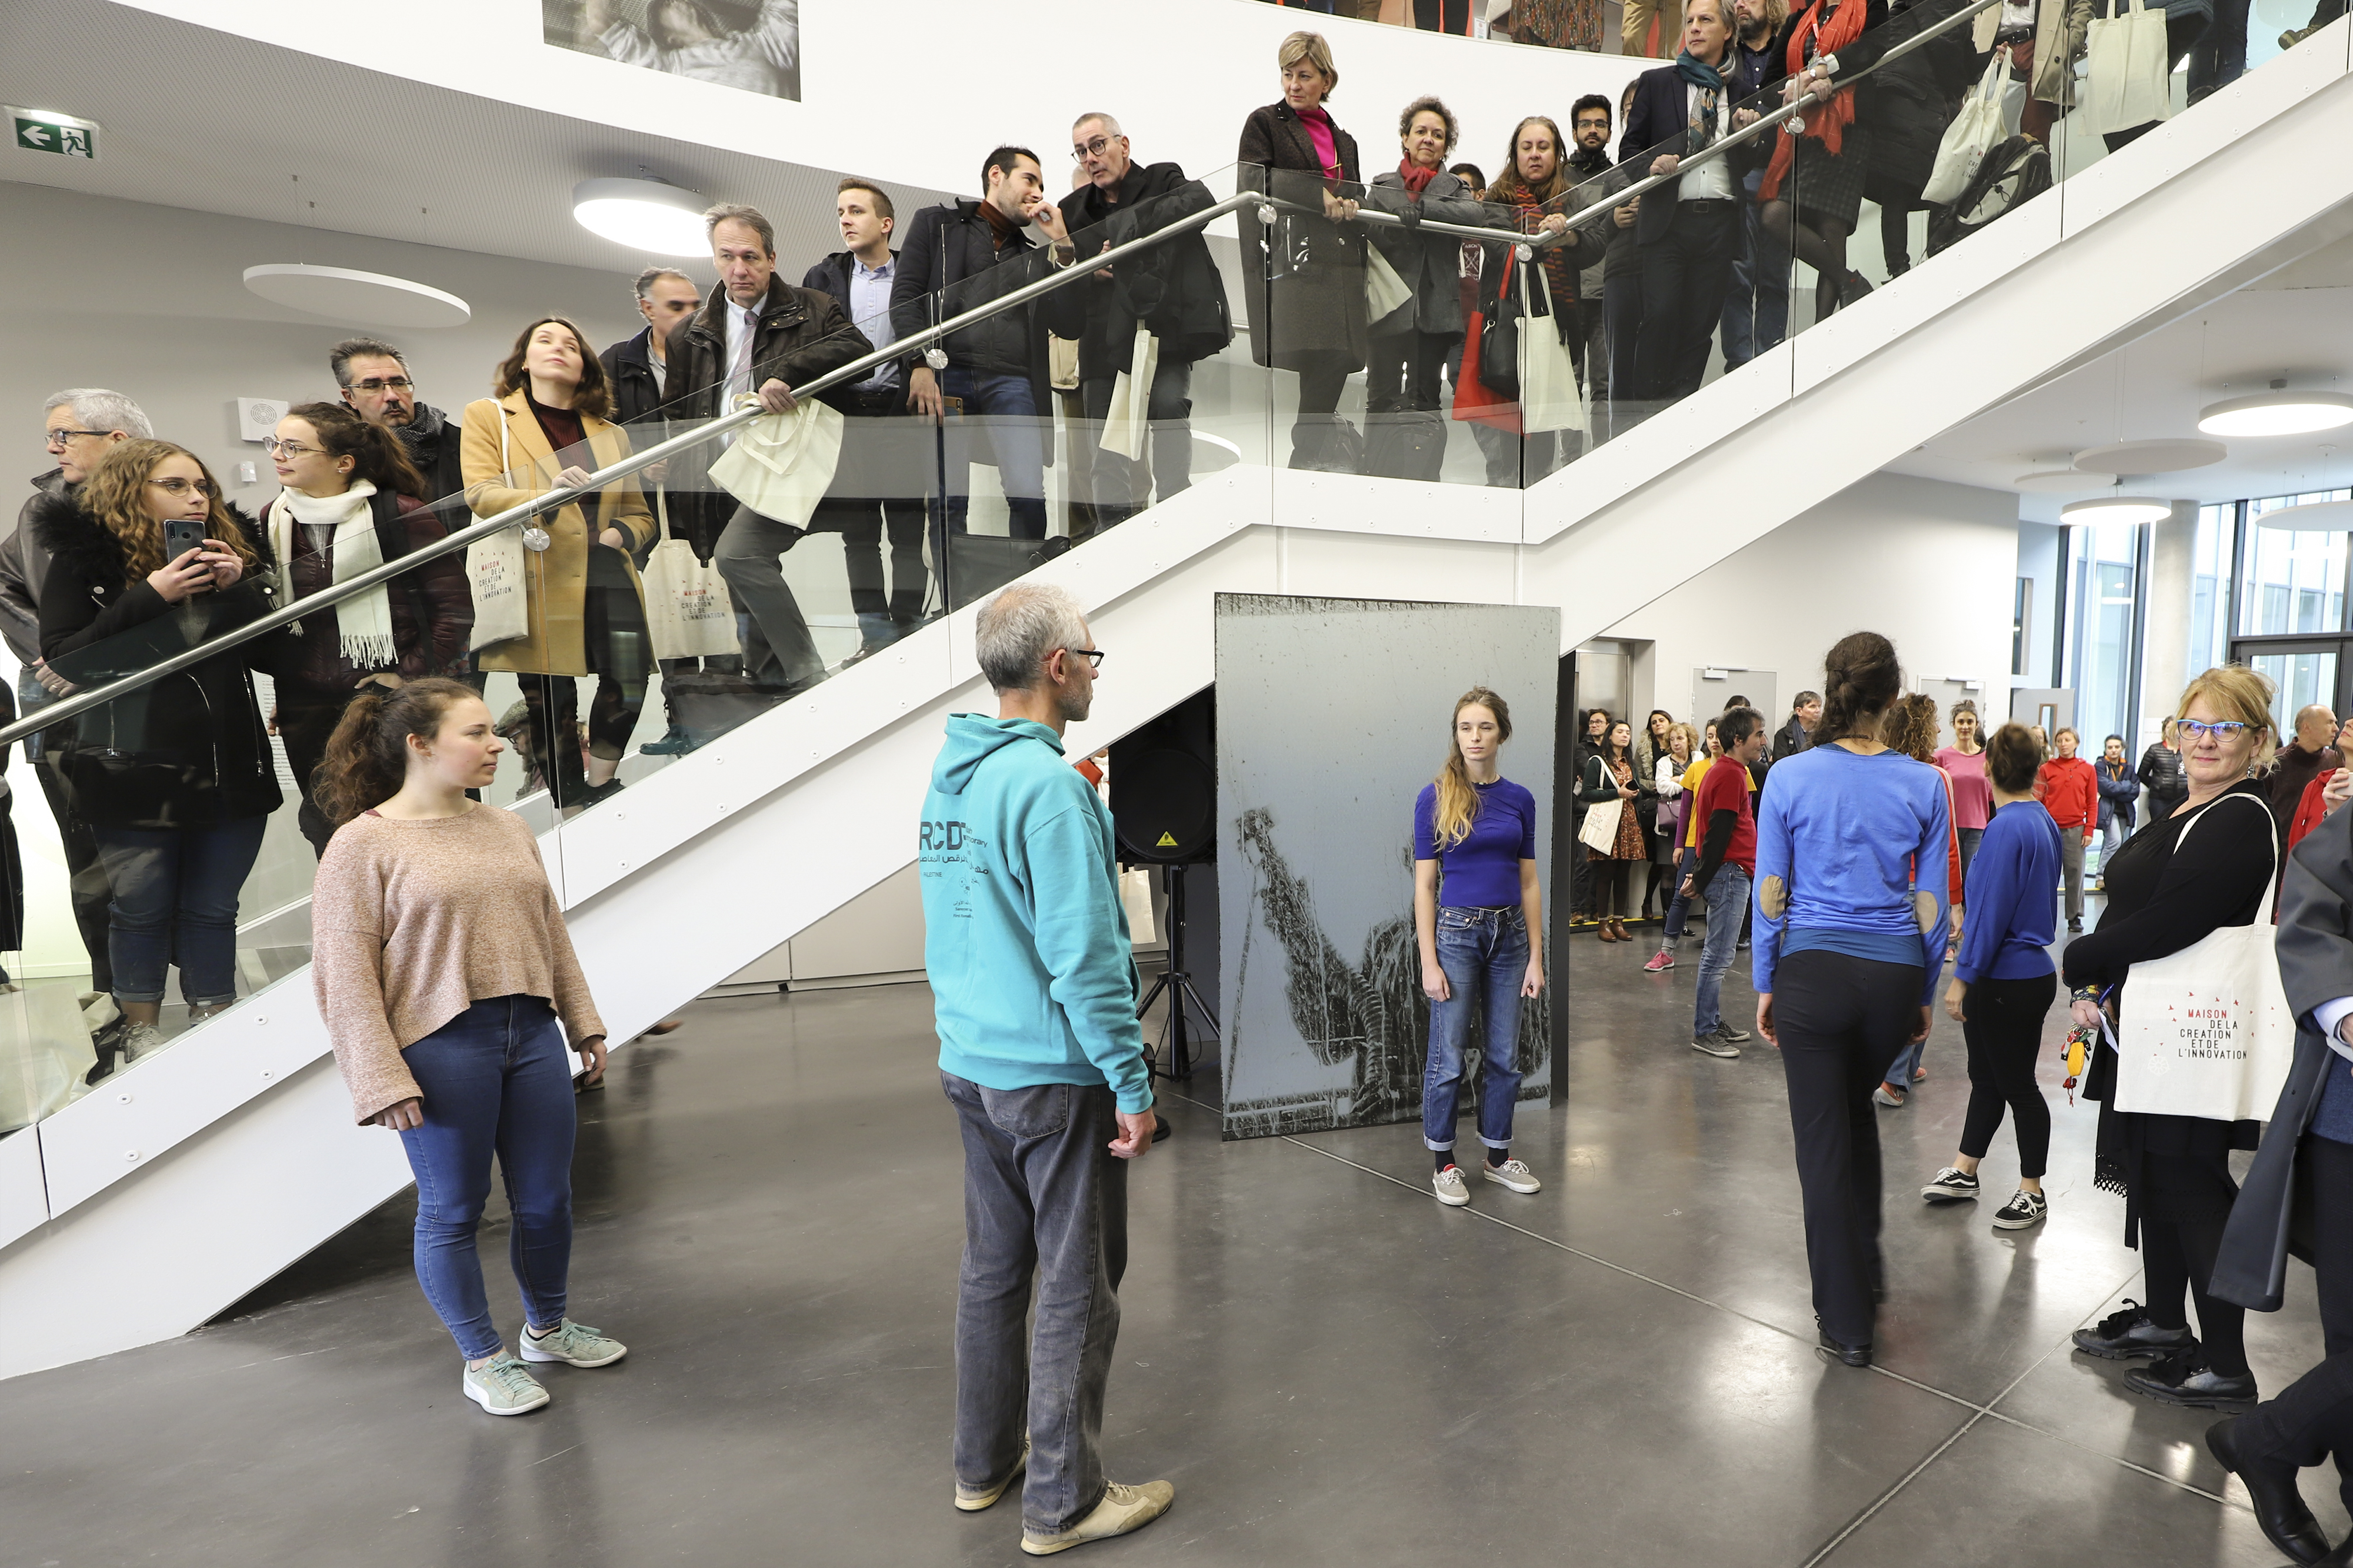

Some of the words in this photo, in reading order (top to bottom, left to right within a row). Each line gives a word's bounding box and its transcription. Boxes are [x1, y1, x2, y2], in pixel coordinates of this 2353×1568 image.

[481, 560, 499, 571] MAISON
[491, 568, 497, 576] DE
[498, 566, 505, 574] LA
[479, 574, 501, 587] CREATION
[479, 586, 511, 602] L'INNOVATION
[484, 585, 489, 593] ET
[682, 612, 725, 621] L'INNOVATION
[919, 821, 966, 850] RCD
[2188, 1009, 2227, 1019] MAISON
[2210, 1020, 2222, 1029] DE
[2226, 1020, 2238, 1029] LA
[2180, 1029, 2231, 1039] CREATION
[2191, 1039, 2203, 1048] ET
[2207, 1040, 2219, 1049] DE
[2178, 1048, 2247, 1059] L'INNOVATION
